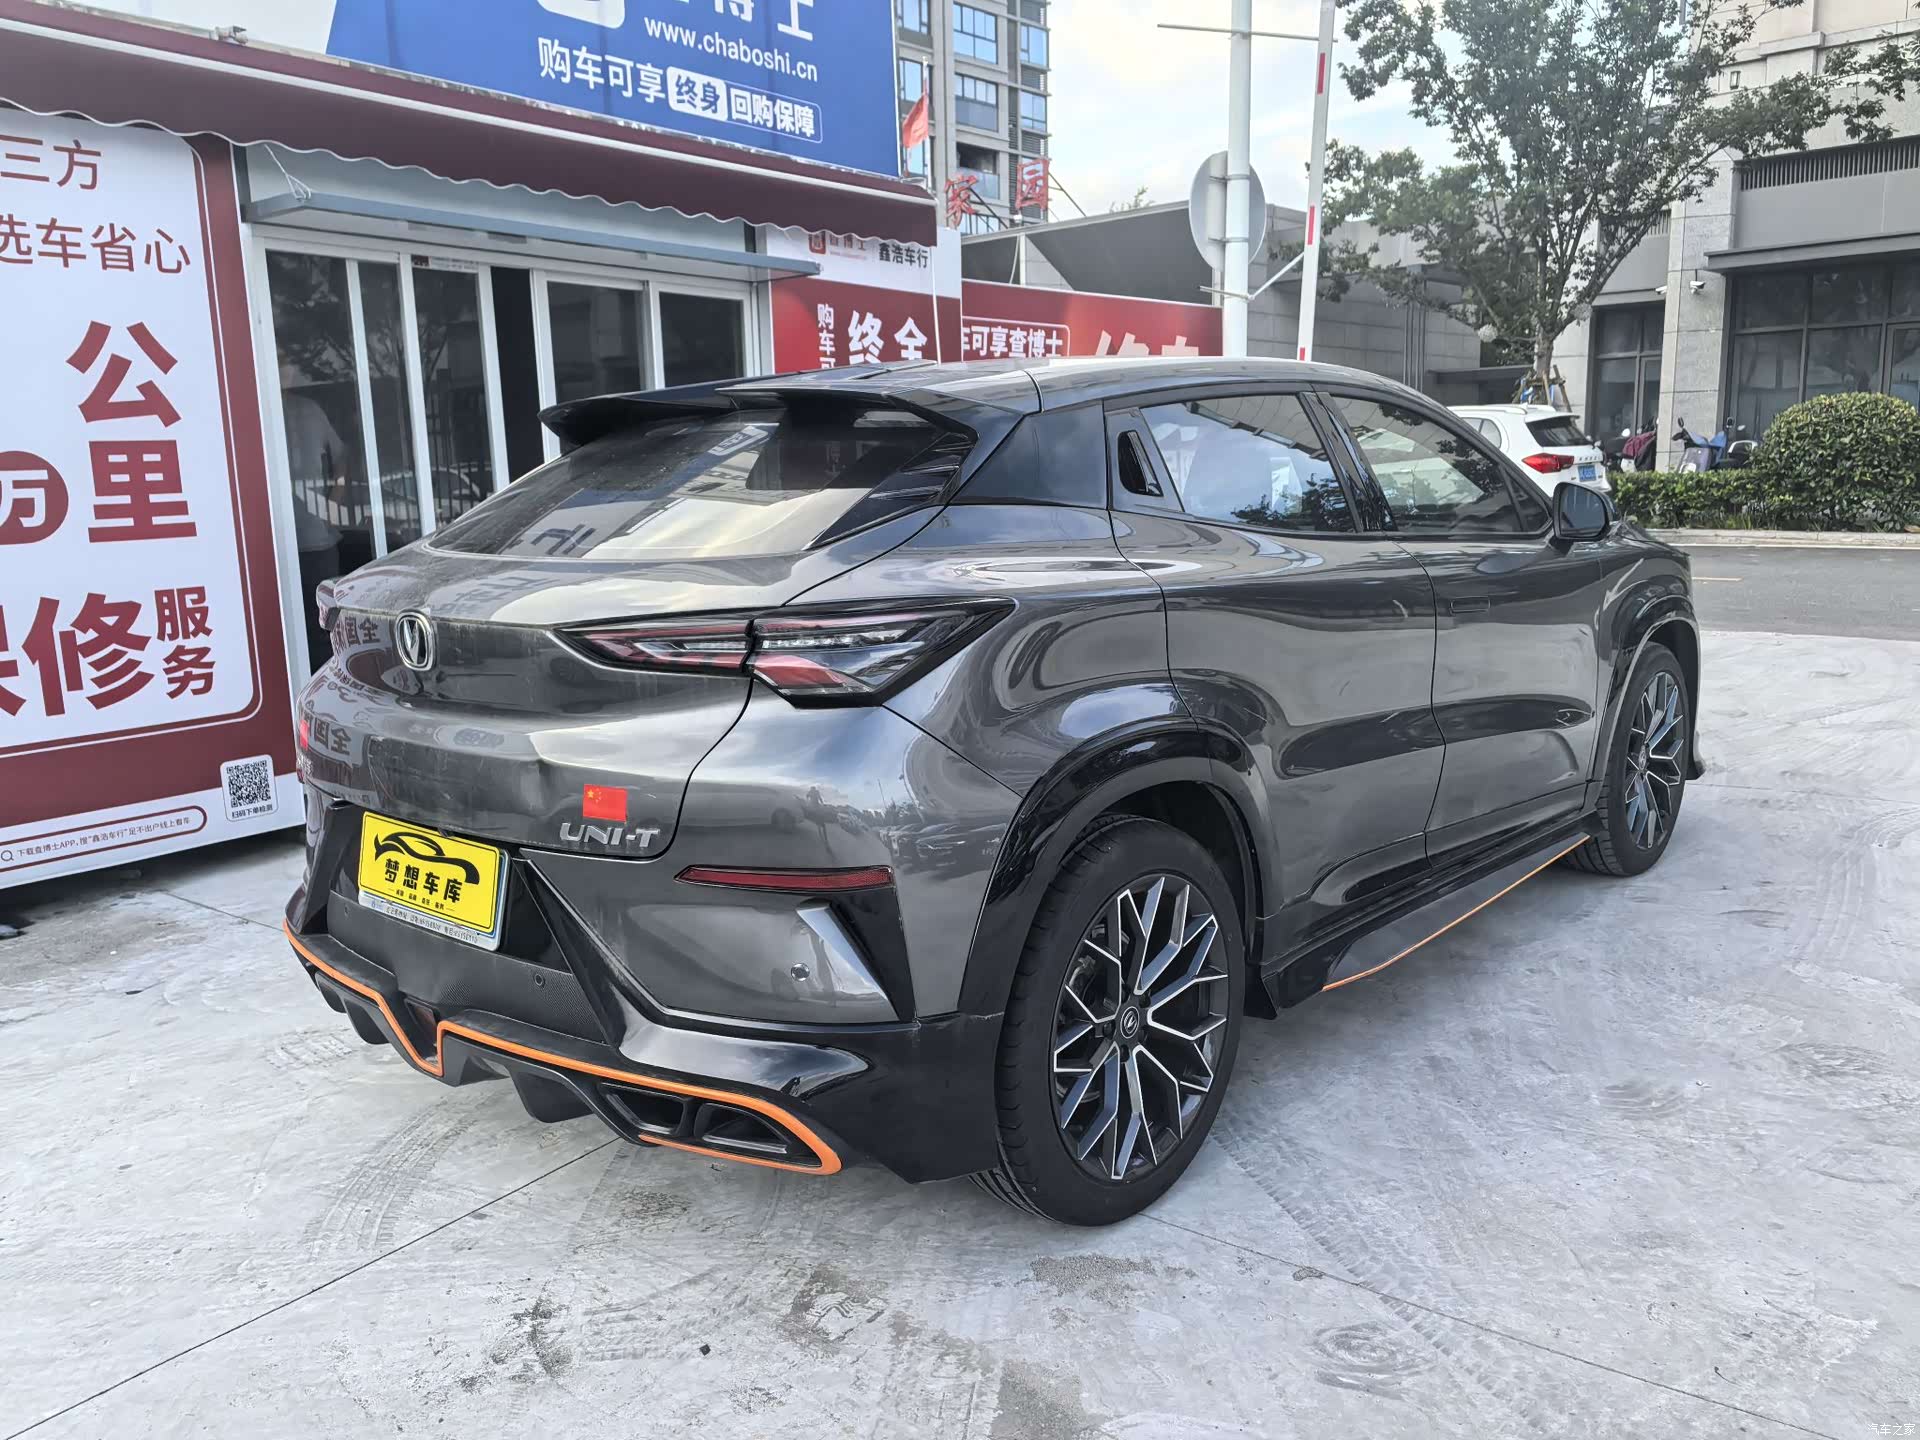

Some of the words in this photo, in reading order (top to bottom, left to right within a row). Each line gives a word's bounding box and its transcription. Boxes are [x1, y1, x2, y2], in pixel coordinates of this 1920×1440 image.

[643, 16, 818, 82] www.chaboshi.cn
[0, 134, 102, 191] 三方
[0, 213, 191, 274] 选车省心
[879, 242, 929, 269] 鑫浩车行
[66, 320, 197, 543] 公里
[154, 586, 216, 700] 服务
[560, 822, 660, 848] UNI-T
[385, 858, 463, 904] 梦想车库
